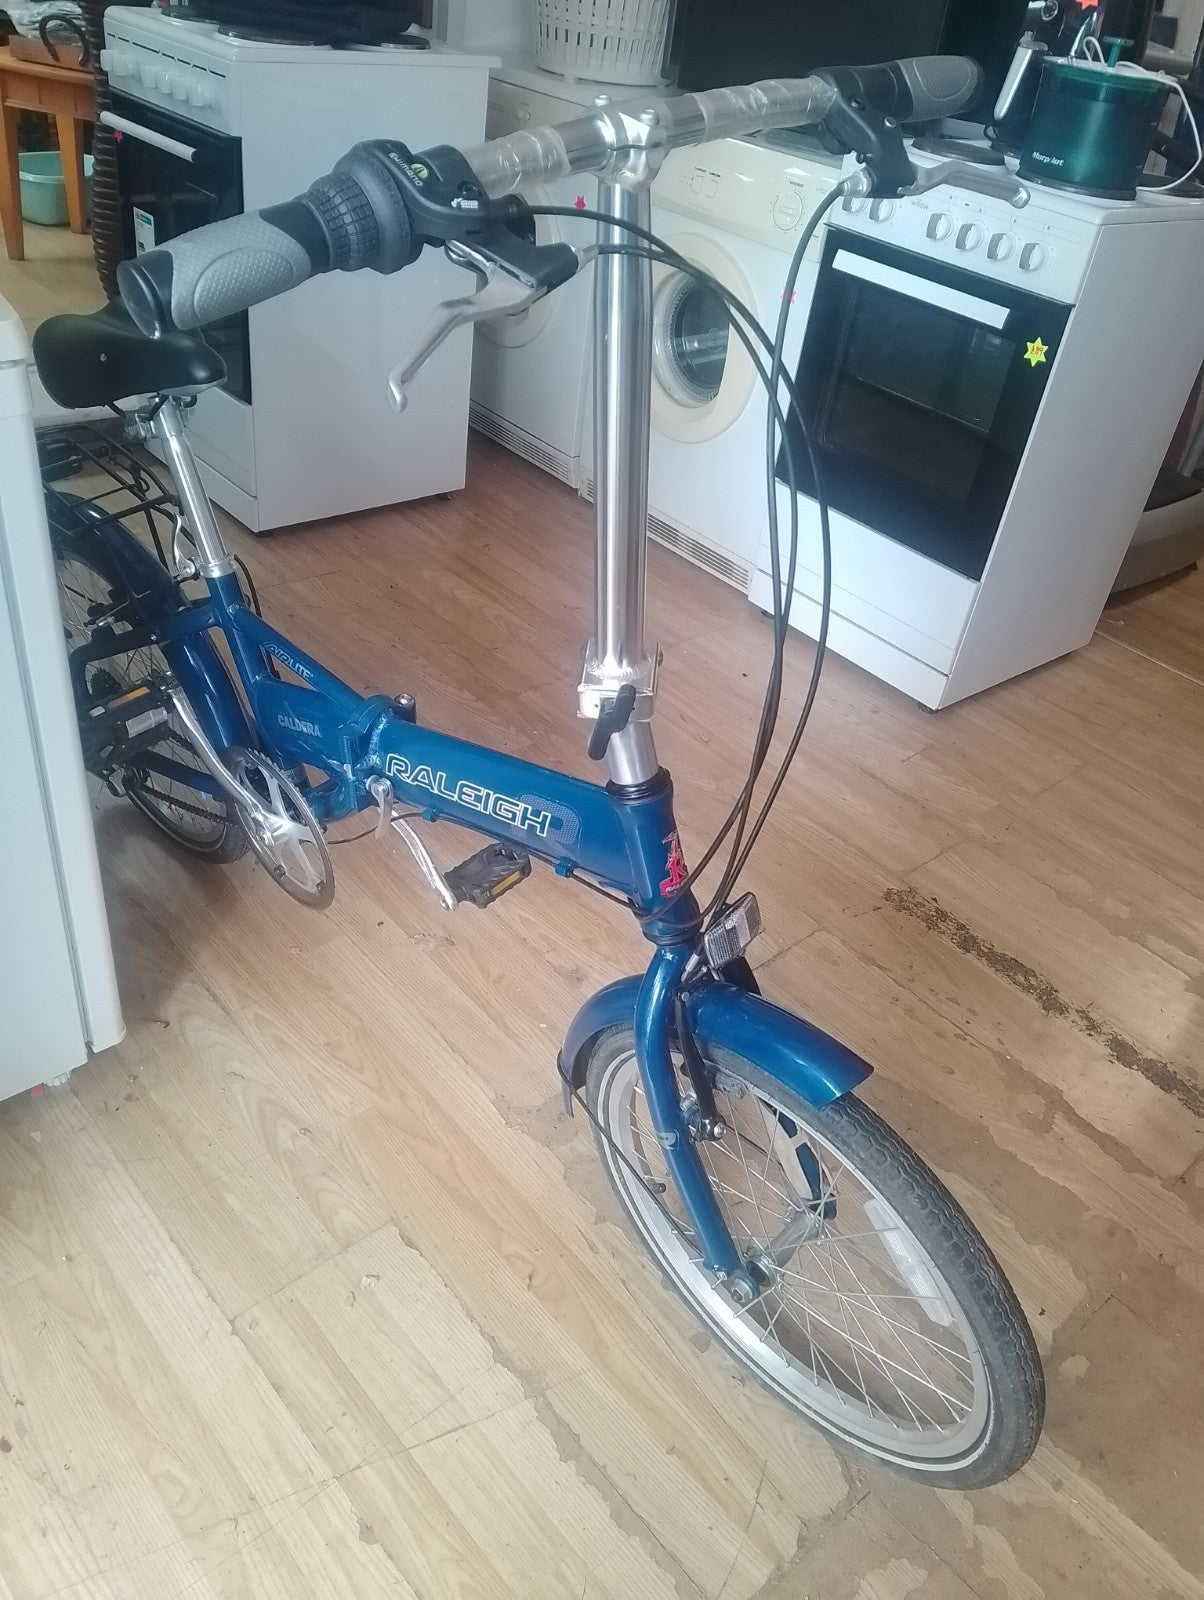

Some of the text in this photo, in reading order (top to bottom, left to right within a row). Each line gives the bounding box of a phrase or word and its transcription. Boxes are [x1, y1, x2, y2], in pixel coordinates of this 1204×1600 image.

[388, 151, 423, 188] SHIMANO
[277, 714, 322, 737] CALDERA
[386, 753, 551, 837] RALEIGH
